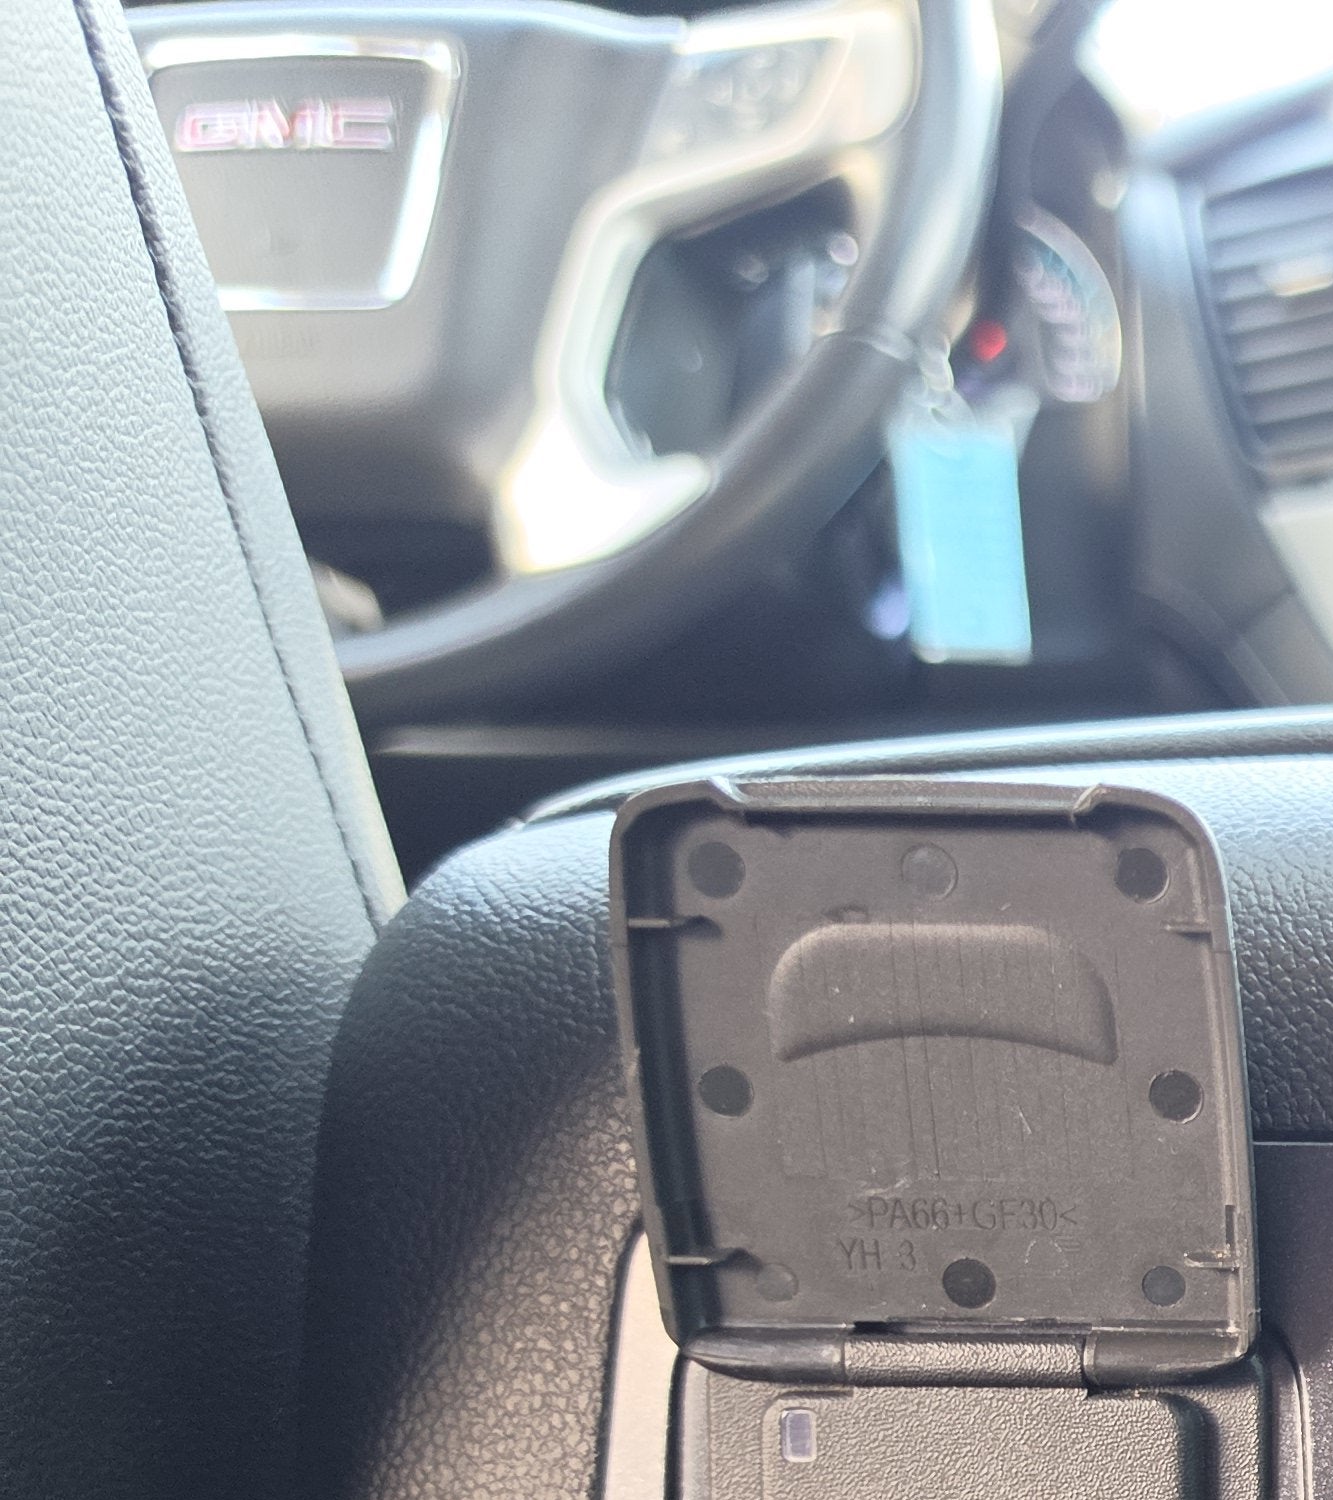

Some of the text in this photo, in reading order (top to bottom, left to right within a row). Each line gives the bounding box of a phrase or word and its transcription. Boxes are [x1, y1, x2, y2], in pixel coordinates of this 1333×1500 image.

[175, 97, 396, 152] GMC
[836, 1237, 918, 1272] YH 3
